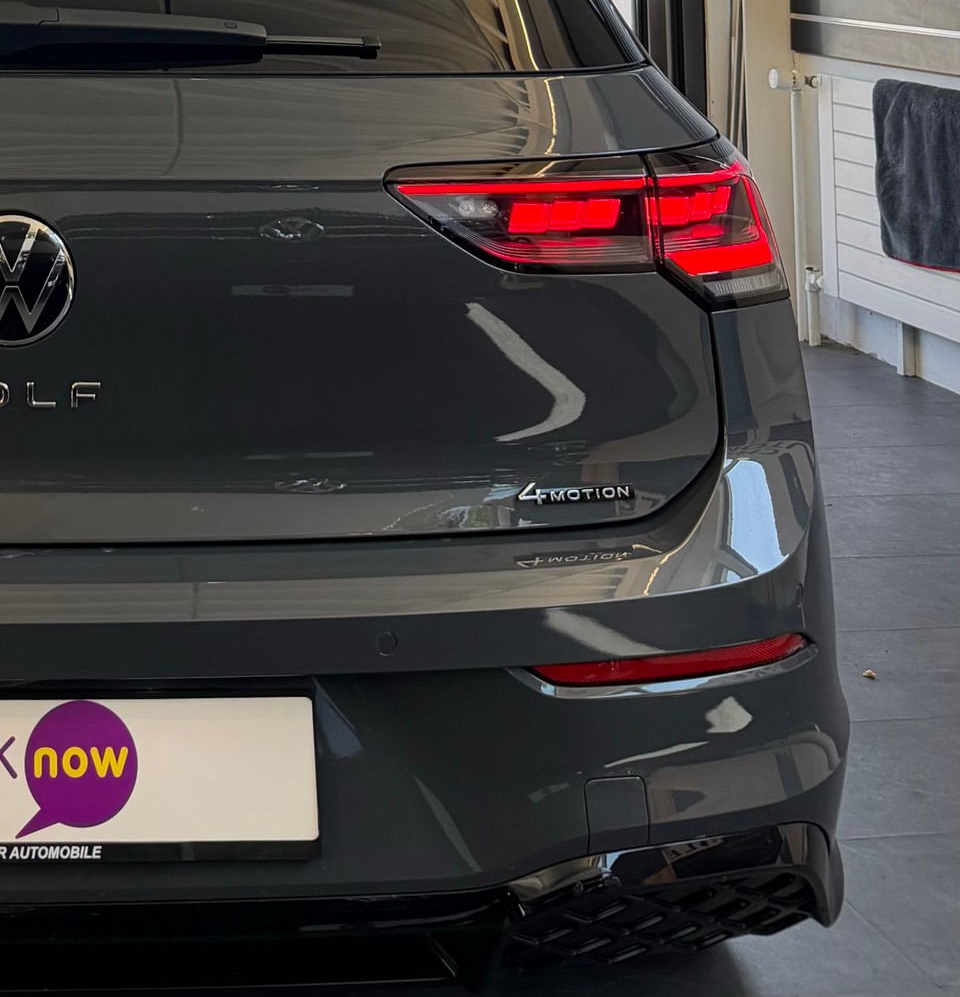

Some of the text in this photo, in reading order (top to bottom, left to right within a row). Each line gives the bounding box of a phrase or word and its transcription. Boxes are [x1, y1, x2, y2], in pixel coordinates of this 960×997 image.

[517, 482, 630, 505] 4MOTION
[33, 746, 129, 779] now
[9, 845, 102, 860] AUTOMOBILE
